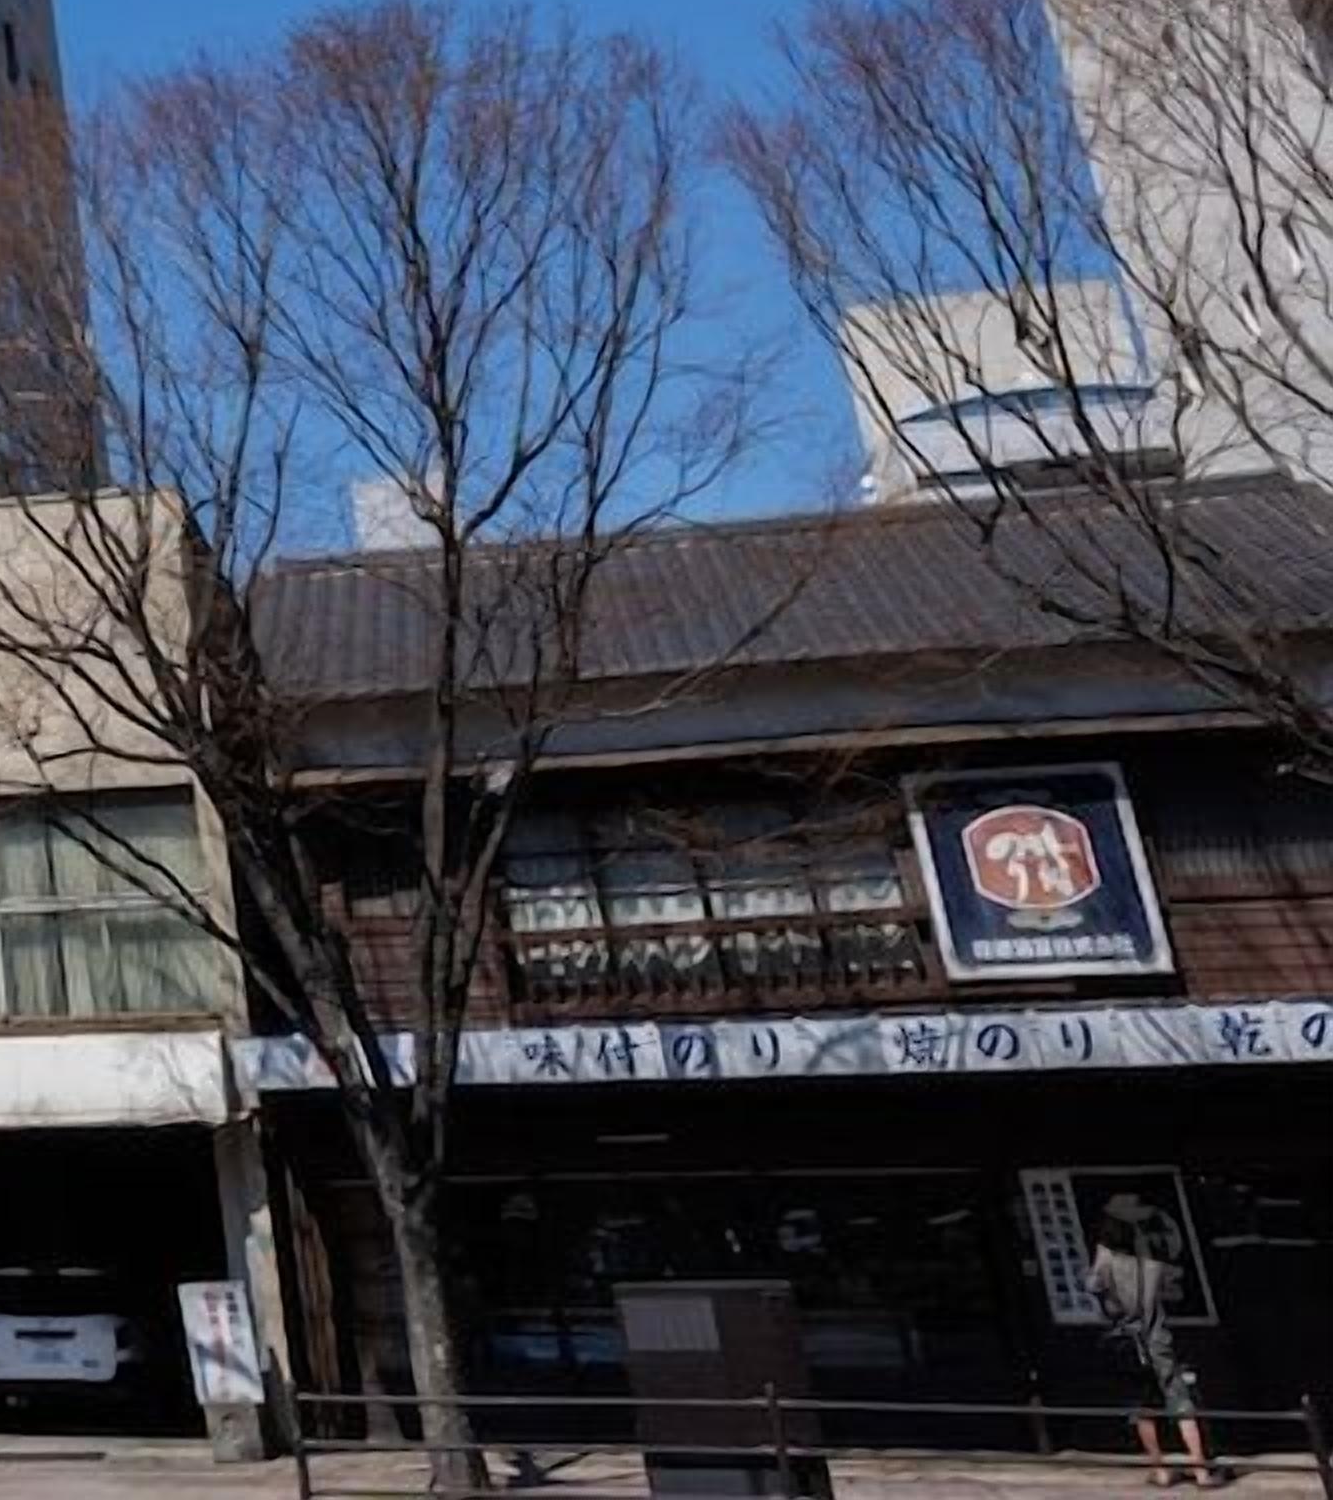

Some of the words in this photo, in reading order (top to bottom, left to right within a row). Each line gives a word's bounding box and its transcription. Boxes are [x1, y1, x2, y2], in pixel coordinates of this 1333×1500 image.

[524, 1025, 782, 1076] 味付のり
[894, 1018, 1094, 1068] 焼のり
